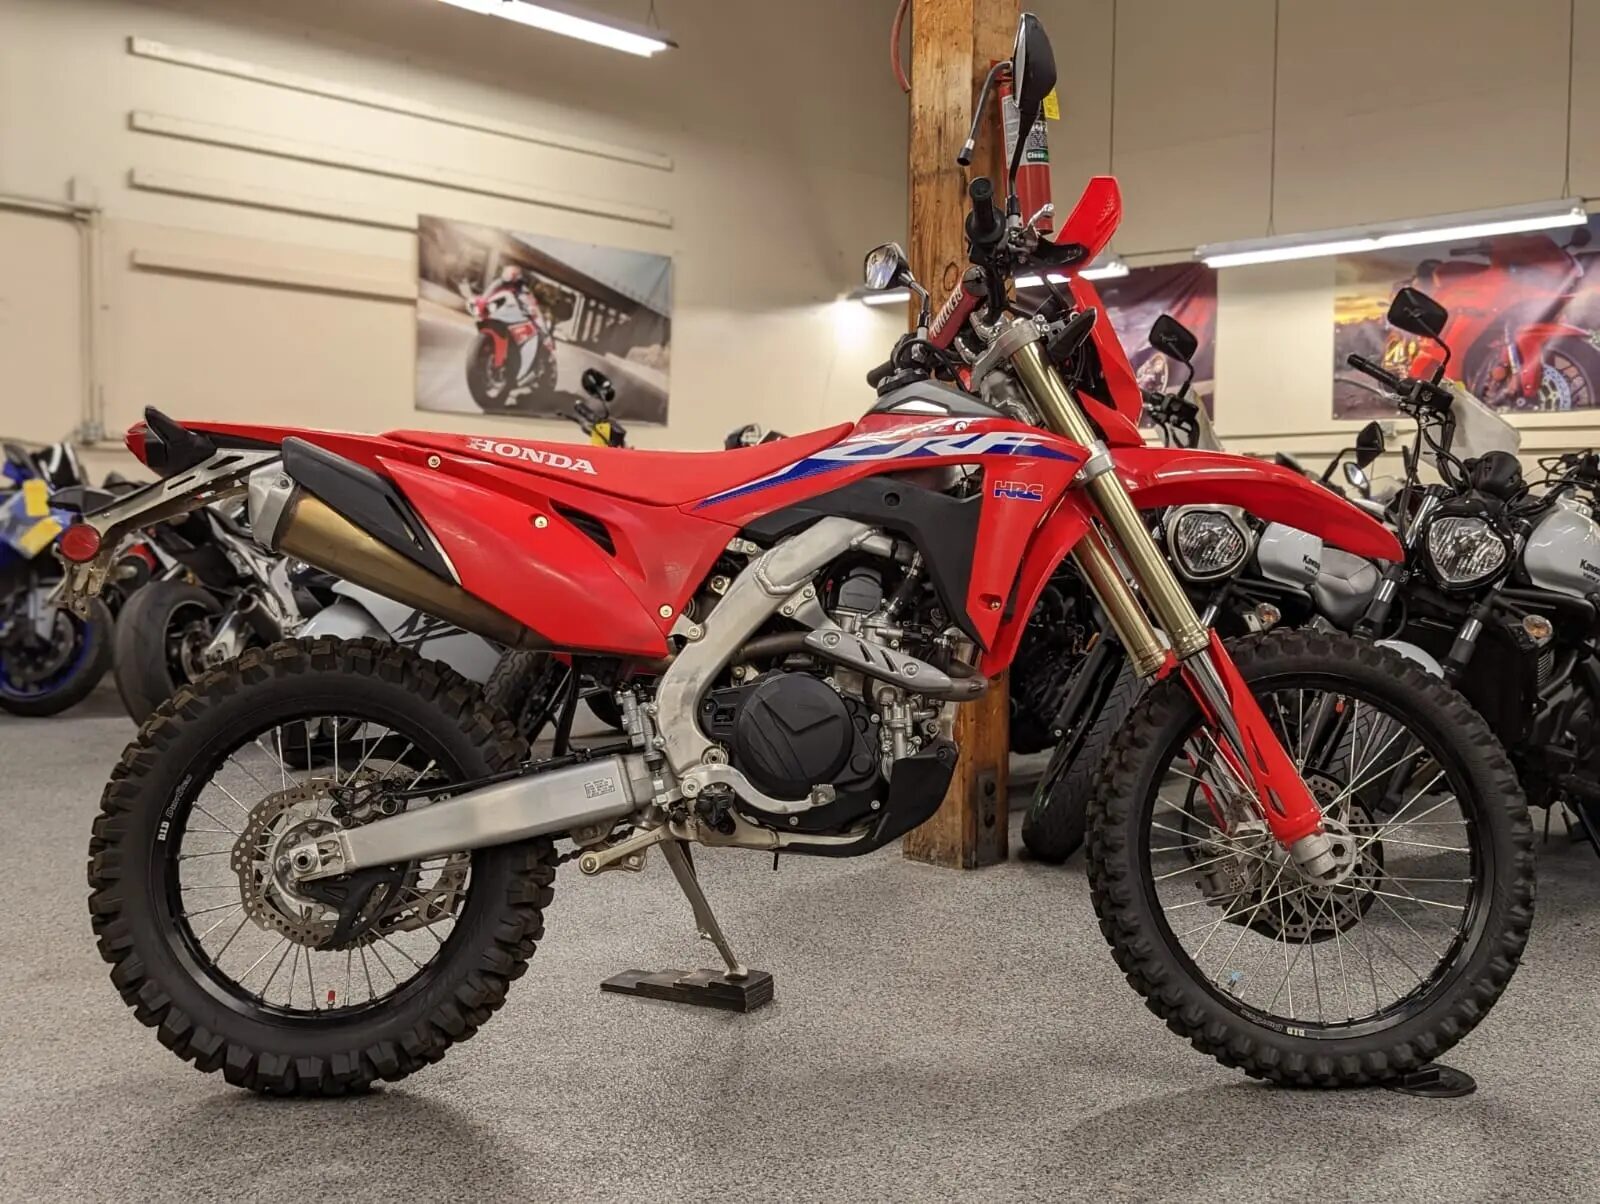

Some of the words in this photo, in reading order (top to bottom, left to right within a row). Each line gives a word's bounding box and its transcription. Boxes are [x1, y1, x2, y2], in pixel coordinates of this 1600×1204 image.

[929, 287, 963, 337] RENTHAL
[466, 437, 598, 475] HONDA
[808, 431, 1056, 460] CRF
[994, 481, 1043, 501] HRC
